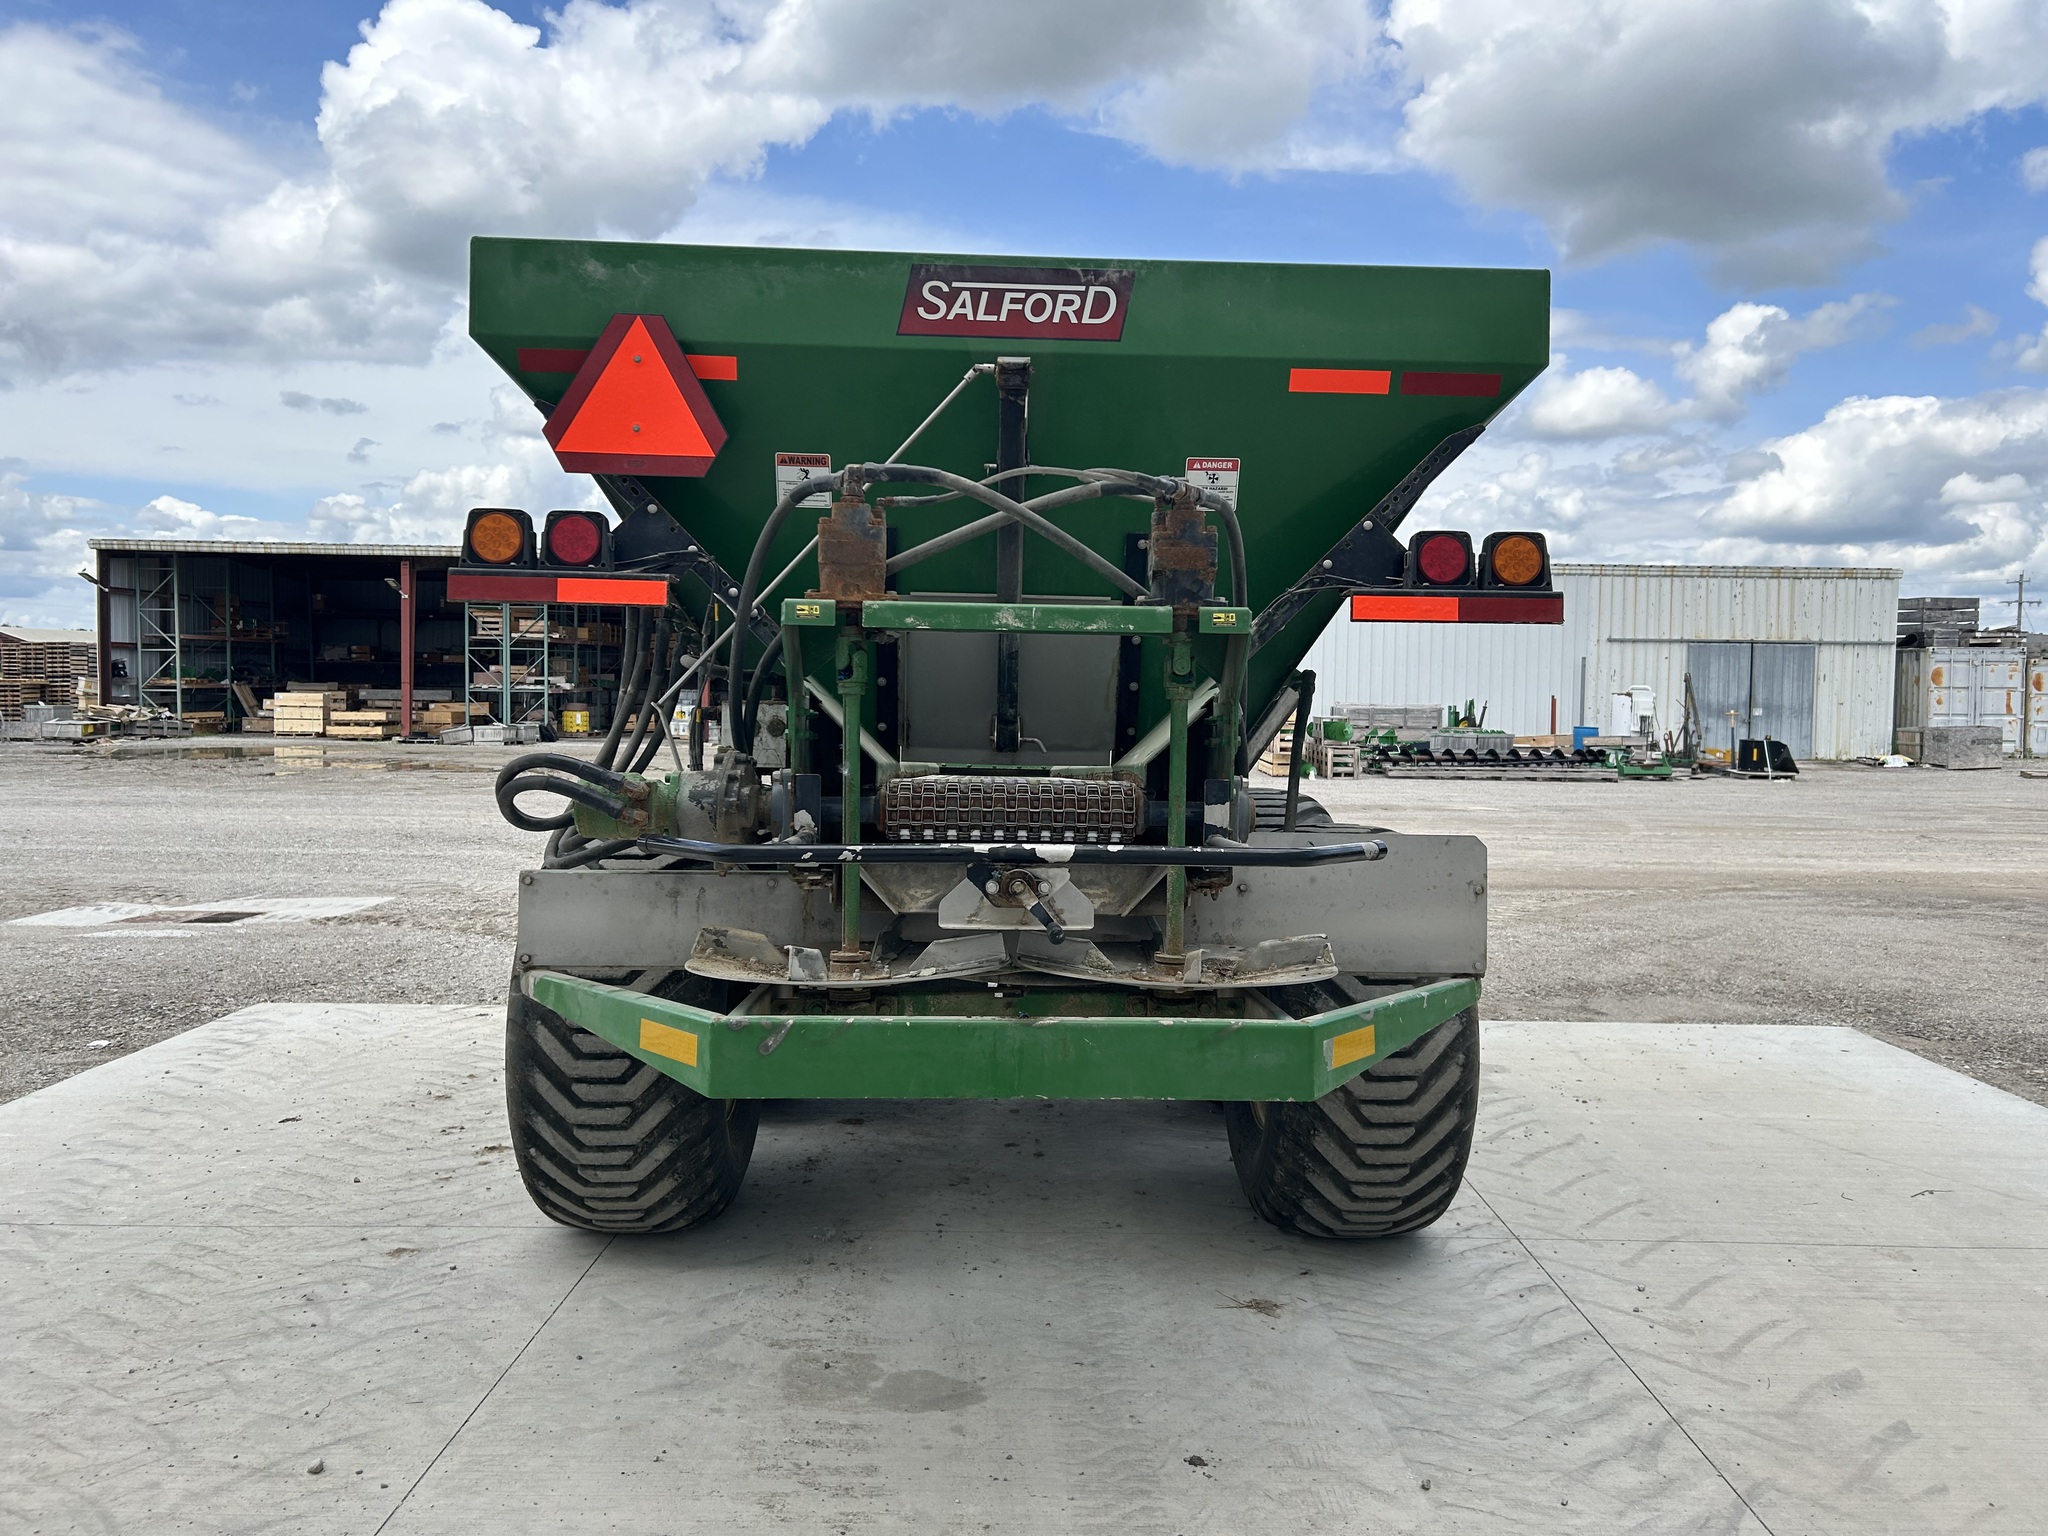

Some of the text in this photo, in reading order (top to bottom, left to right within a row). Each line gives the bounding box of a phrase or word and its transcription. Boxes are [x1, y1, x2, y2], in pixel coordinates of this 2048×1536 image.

[917, 280, 1118, 325] SALFORD
[788, 456, 827, 465] WARNING
[1202, 461, 1233, 469] DANGER
